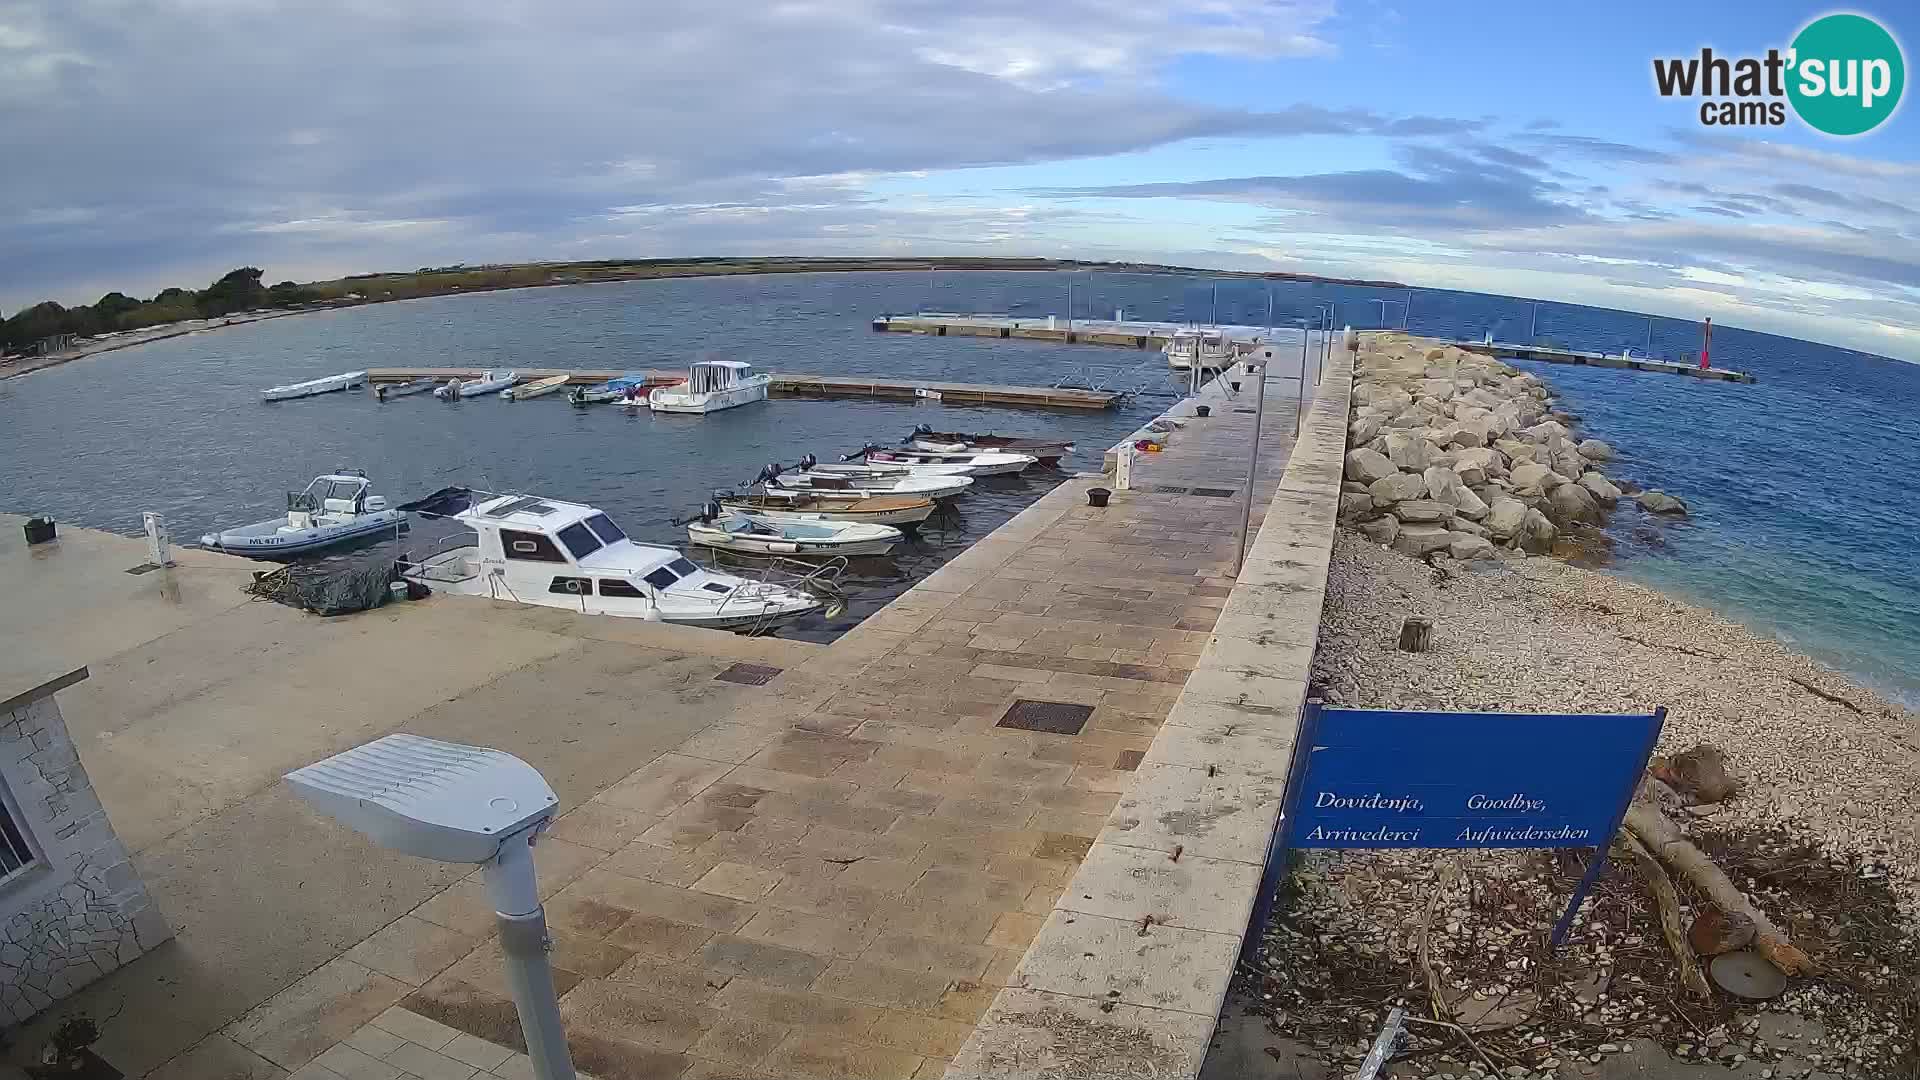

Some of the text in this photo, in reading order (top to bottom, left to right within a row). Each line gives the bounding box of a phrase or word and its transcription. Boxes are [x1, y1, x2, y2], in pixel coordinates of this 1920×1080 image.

[1314, 792, 1547, 813] Doviđenja, Goodbye,
[1306, 824, 1590, 843] Arrivederci Aufwiedersehen
